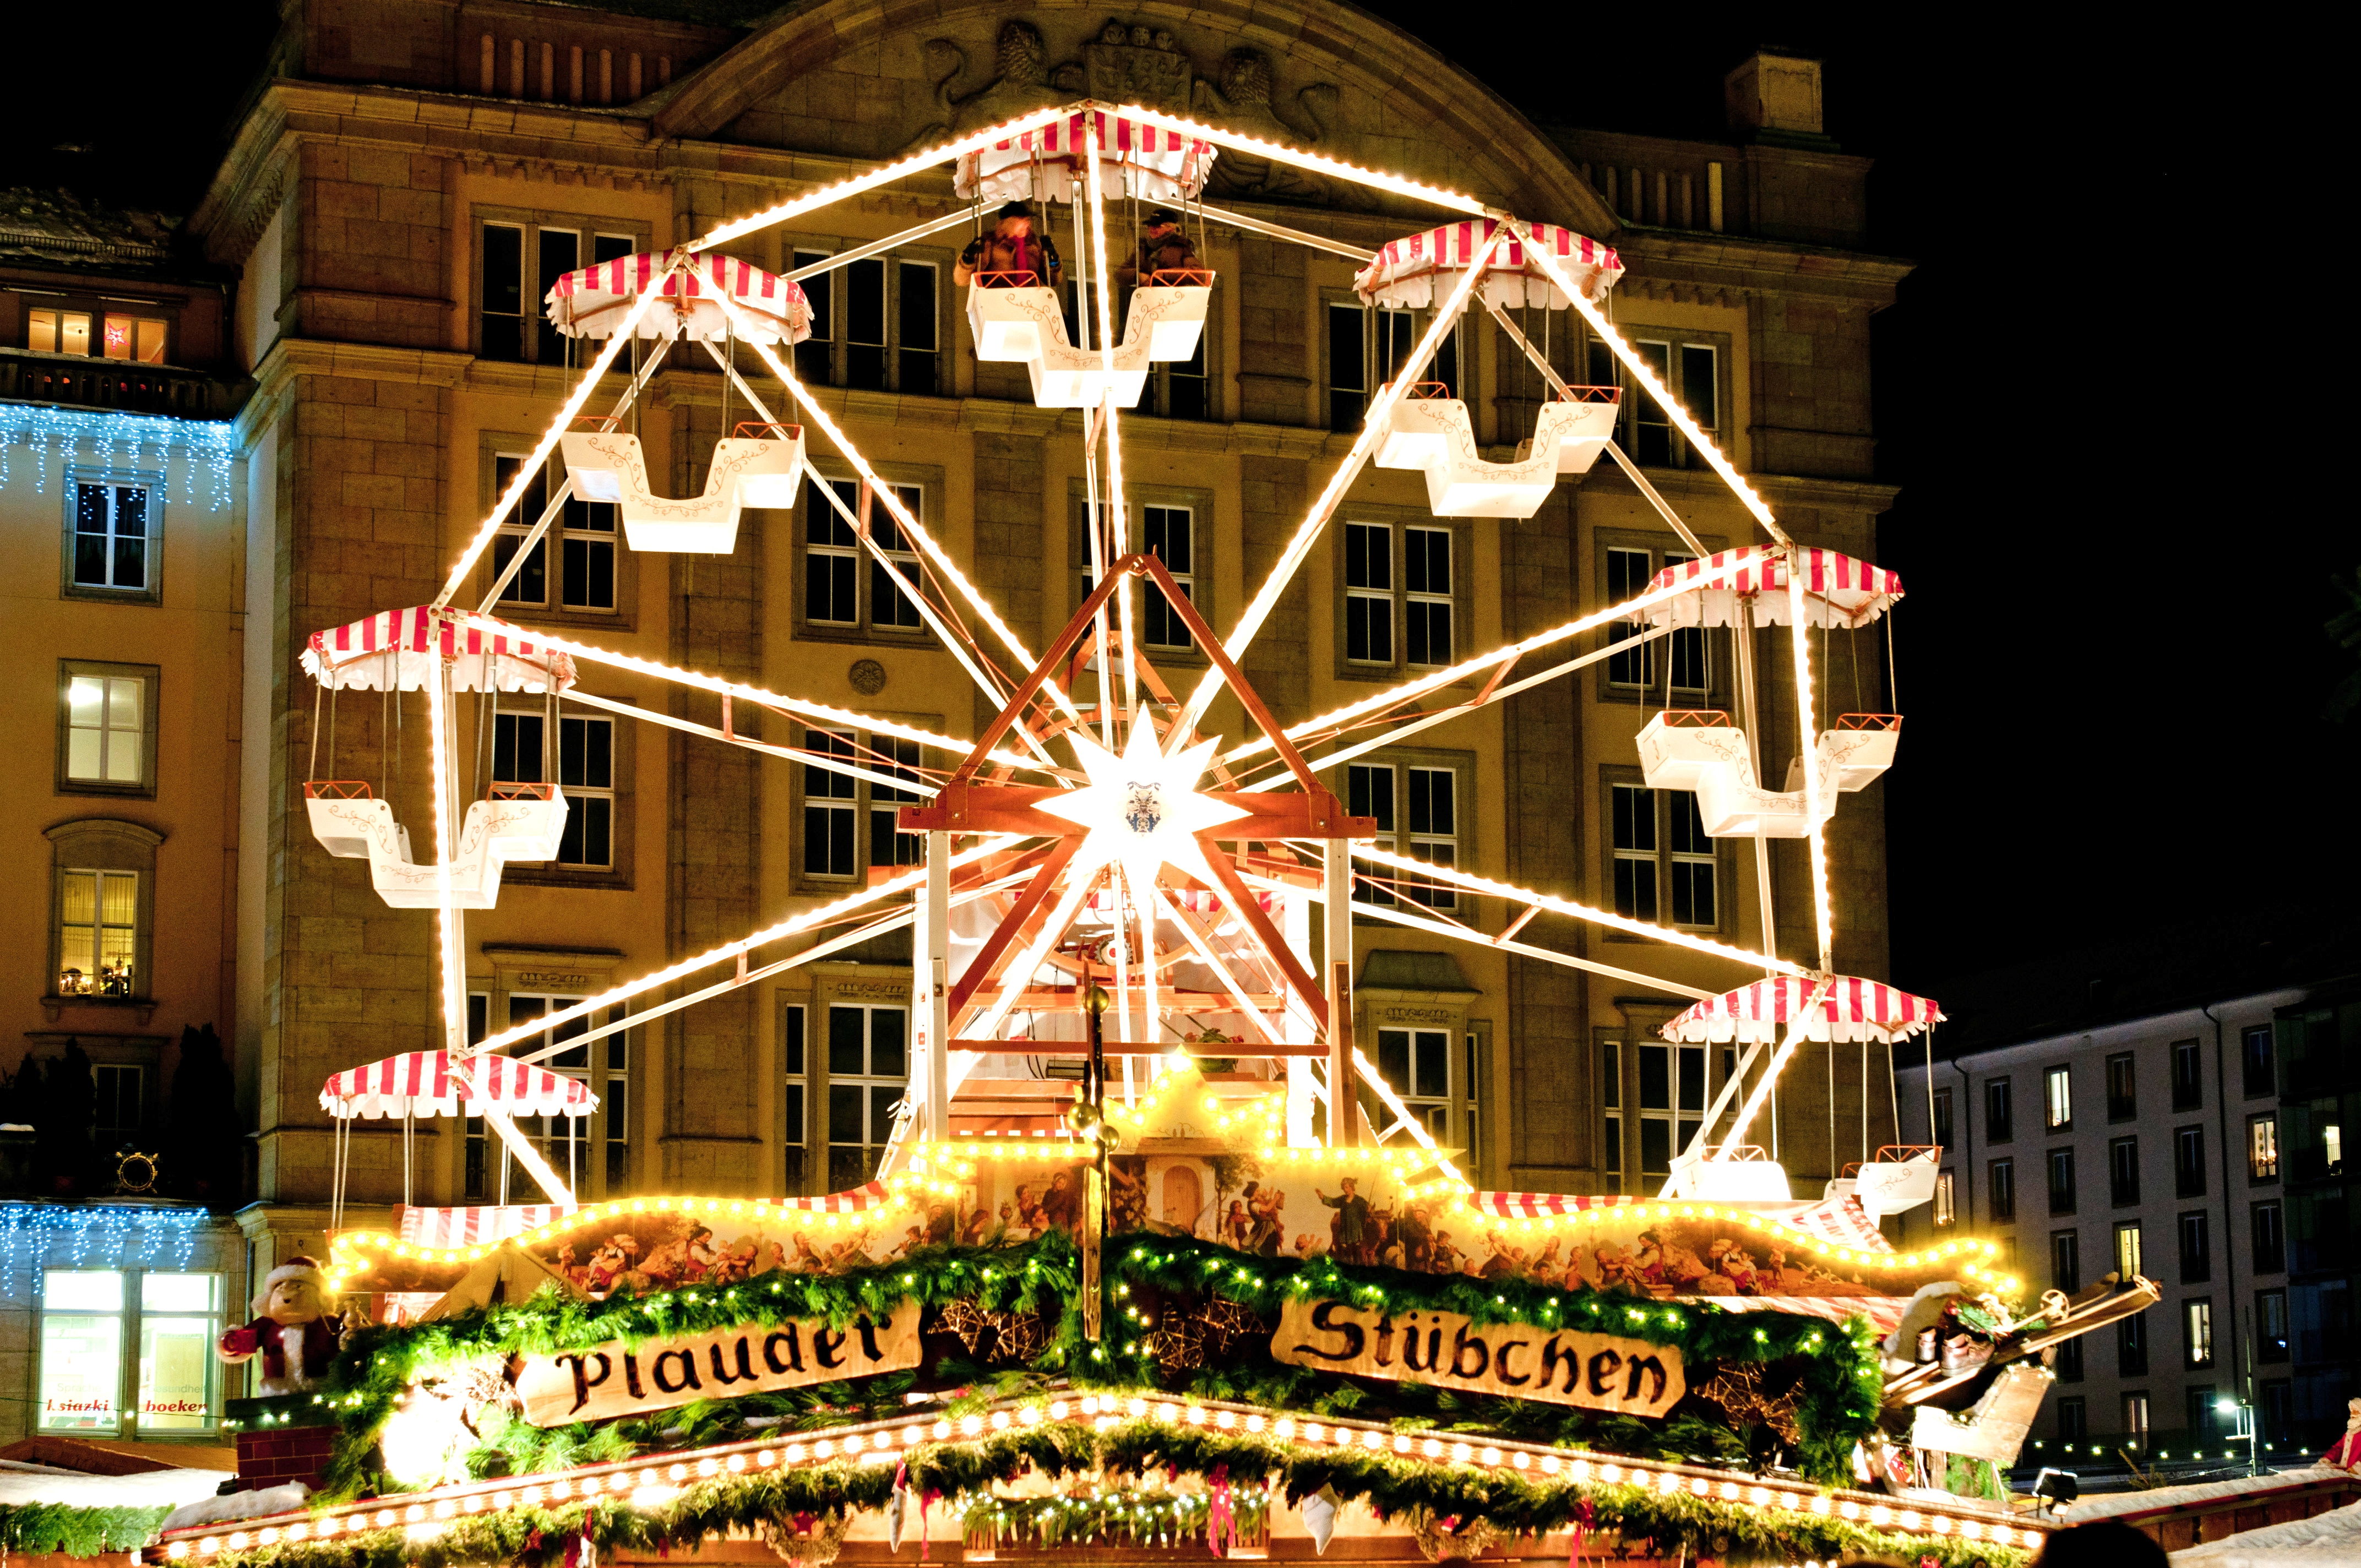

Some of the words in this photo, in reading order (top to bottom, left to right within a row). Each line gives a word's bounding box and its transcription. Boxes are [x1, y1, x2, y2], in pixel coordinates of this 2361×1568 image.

[554, 1313, 893, 1415] Plauder
[1292, 1300, 1668, 1404] Stübchen
[57, 1382, 101, 1393] Sprache
[146, 1400, 208, 1412] boeken
